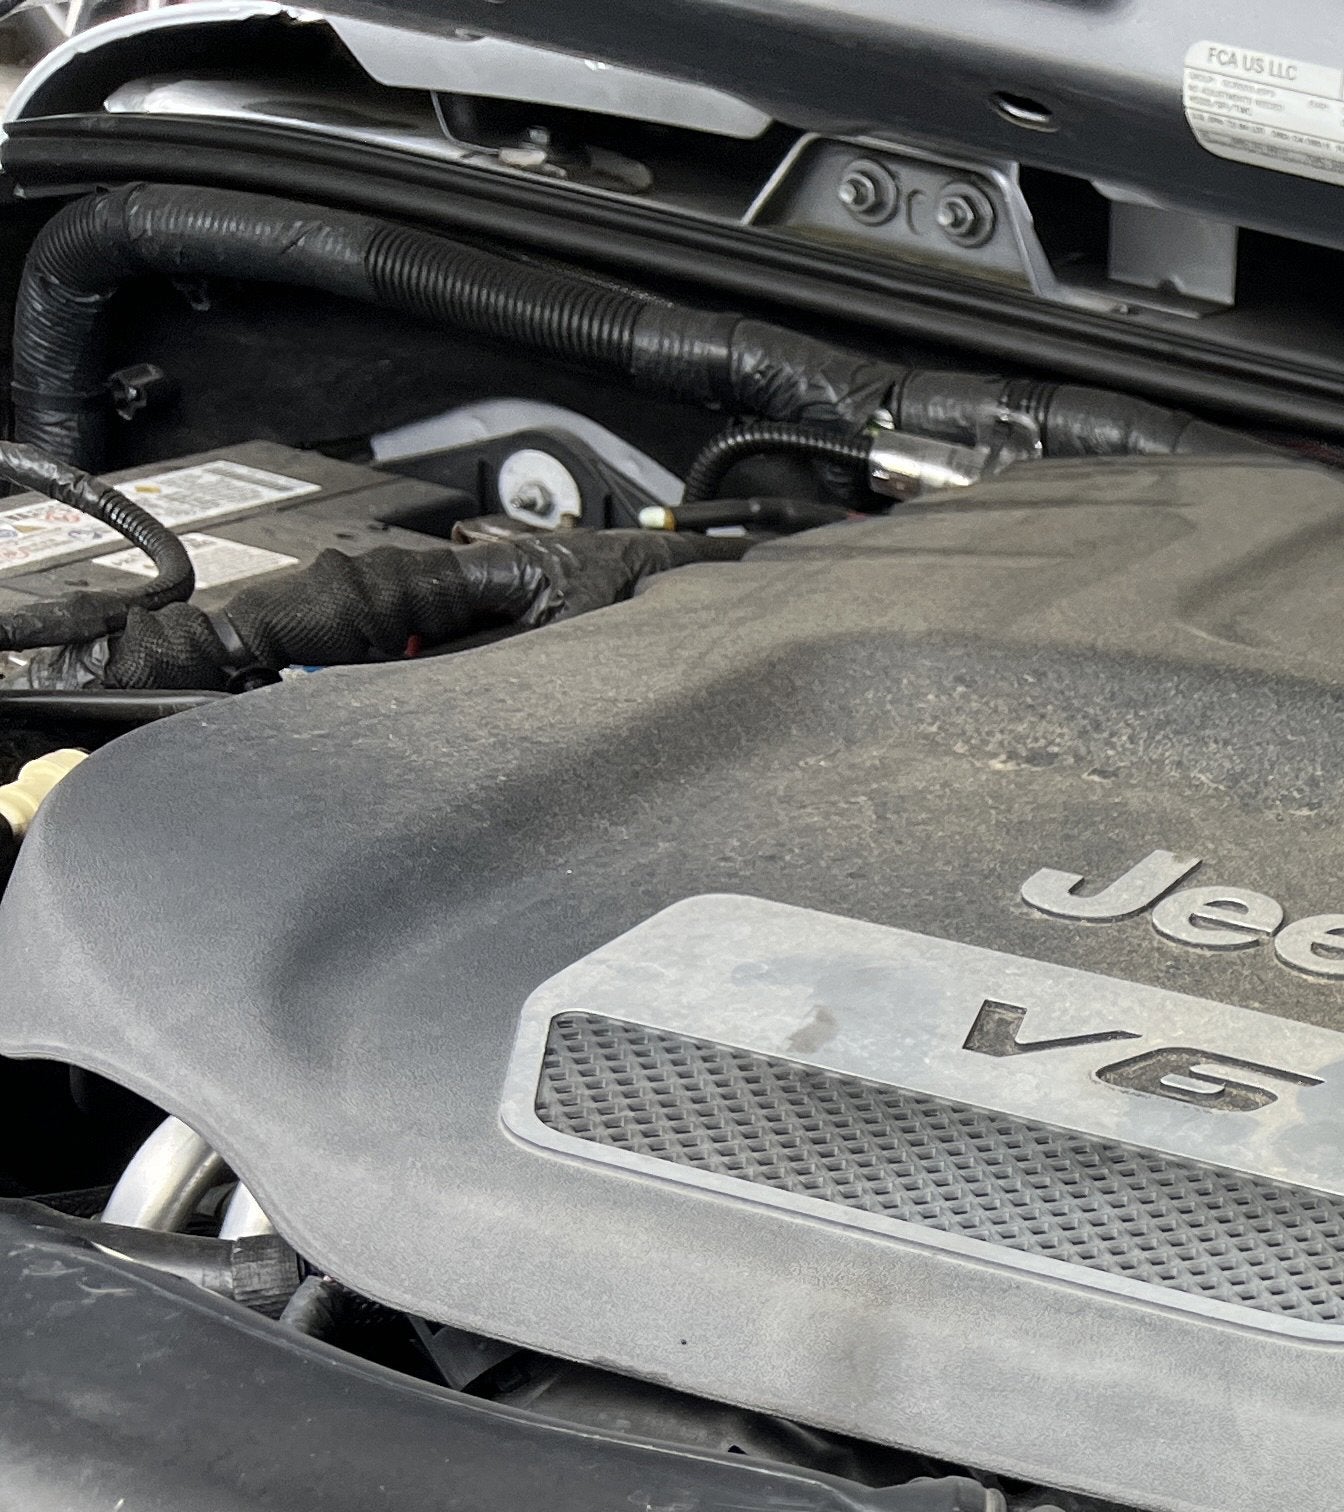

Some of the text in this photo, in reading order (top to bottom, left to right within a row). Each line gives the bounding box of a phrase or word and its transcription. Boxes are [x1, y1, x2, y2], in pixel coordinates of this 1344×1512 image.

[1207, 47, 1298, 81] FCA US LLC
[962, 999, 1326, 1112] V6
